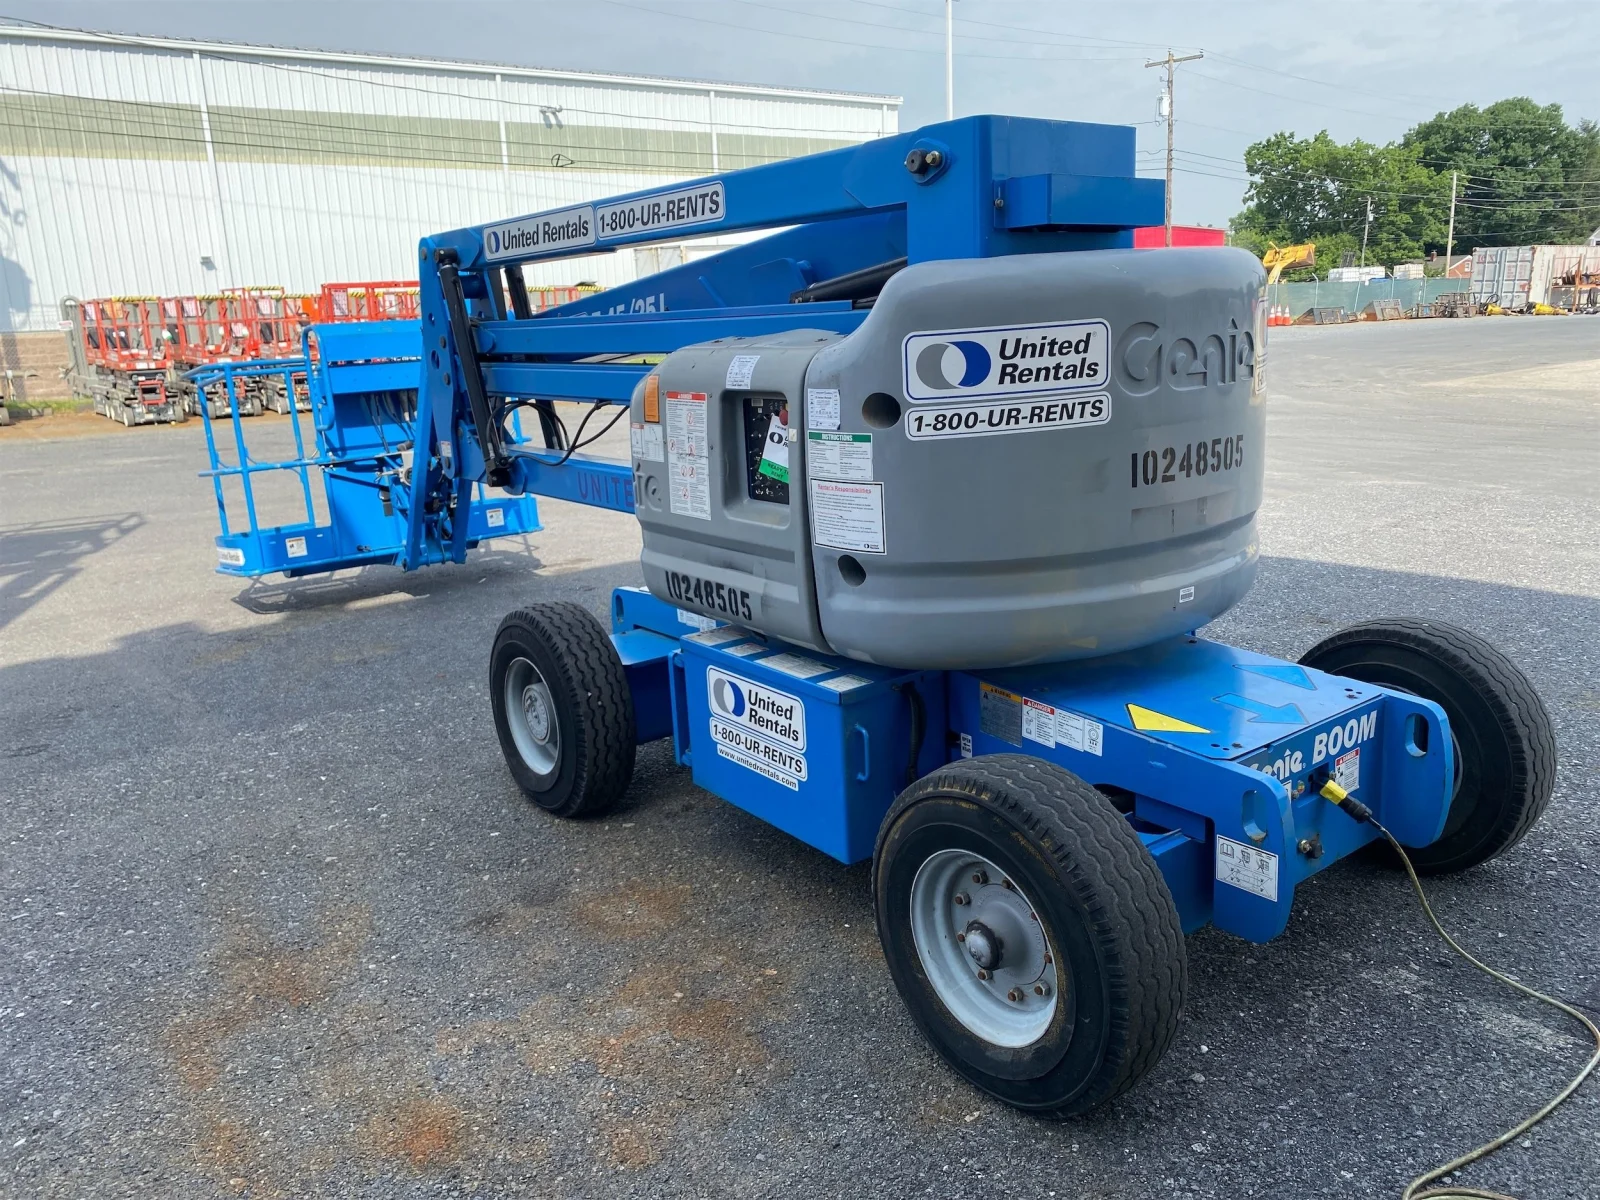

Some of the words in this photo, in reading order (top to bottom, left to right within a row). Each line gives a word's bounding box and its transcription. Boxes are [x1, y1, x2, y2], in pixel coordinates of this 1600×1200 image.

[600, 190, 720, 233] 1-800-UR-RENTS
[502, 226, 539, 251] United
[542, 214, 589, 243] Rentals
[999, 332, 1092, 361] United
[1113, 318, 1254, 397] Genie
[998, 357, 1100, 385] Rentals
[913, 399, 1104, 433] 1-800-UR-RENTS
[821, 433, 853, 442] INSTRUCTIONS
[747, 689, 793, 721] United
[1032, 701, 1051, 714] DANGER
[748, 708, 799, 742] Rentals
[713, 724, 803, 774] 1-800-UR-RENTS
[1249, 748, 1303, 781] enie
[1312, 710, 1378, 765] BOOM
[718, 747, 797, 789] www.unitedrentals.com
